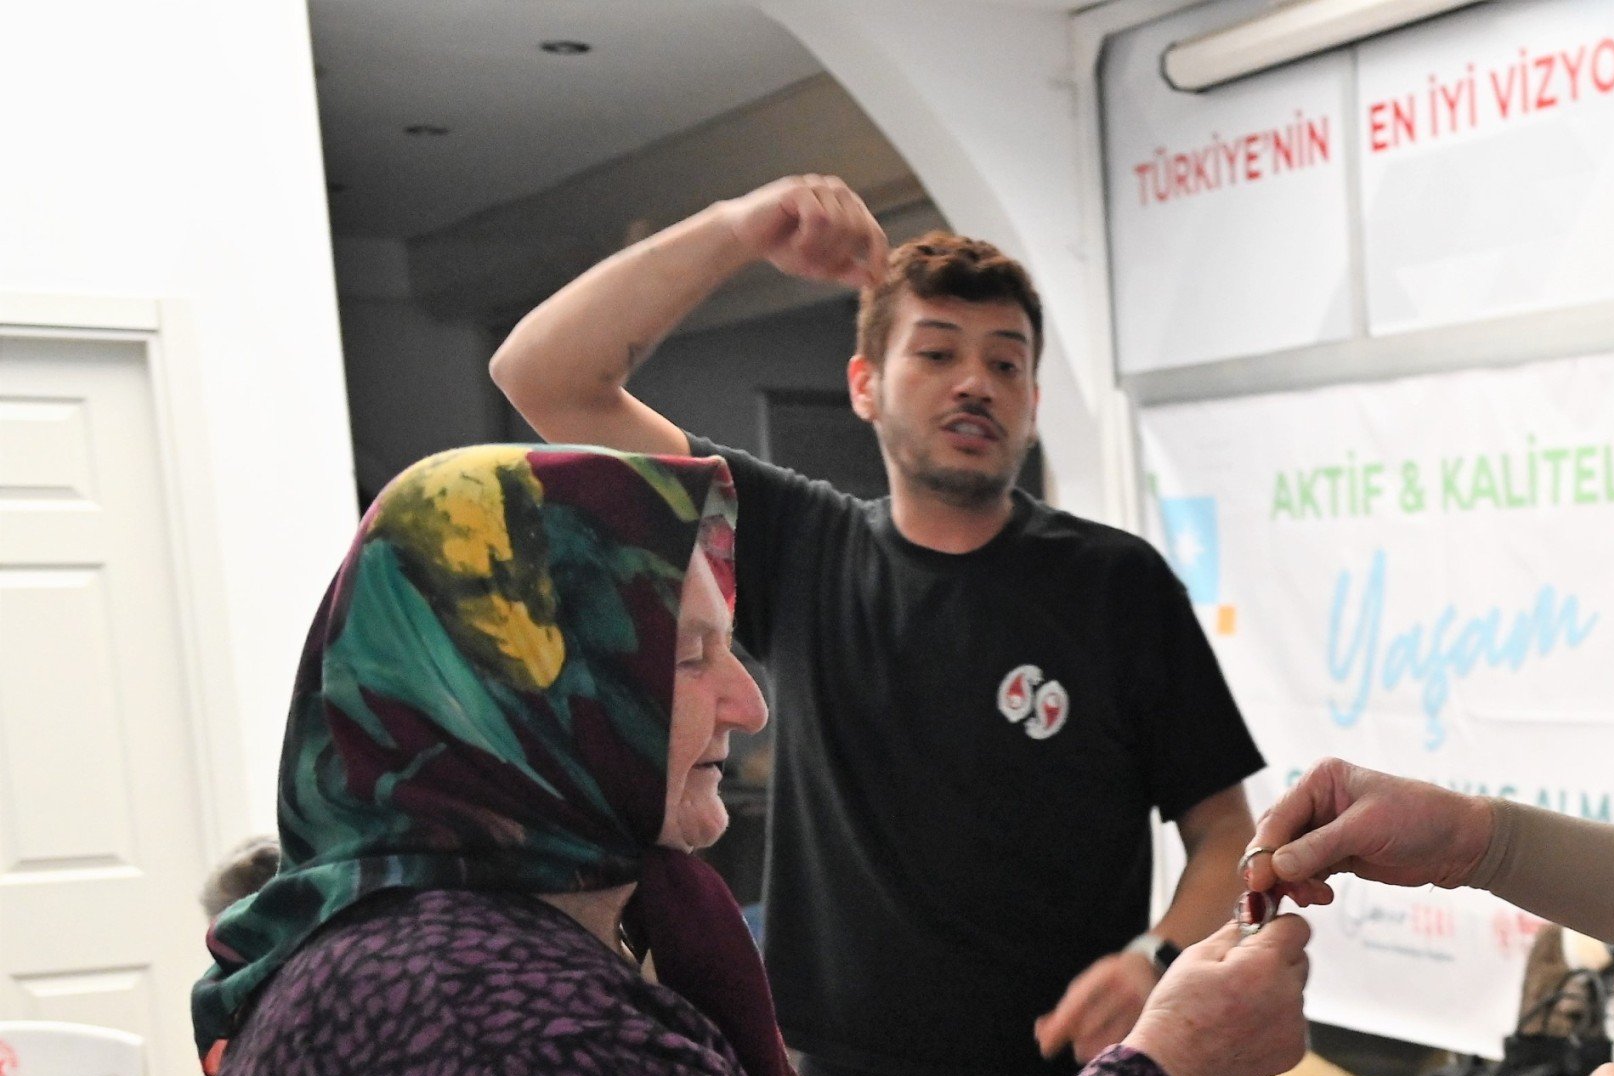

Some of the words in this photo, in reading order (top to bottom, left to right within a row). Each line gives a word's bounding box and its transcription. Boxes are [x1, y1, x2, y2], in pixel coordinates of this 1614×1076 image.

[1135, 110, 1329, 206] TÜRKİYE'NİN
[1369, 93, 1416, 151] EN
[1427, 62, 1477, 136] İYİ
[1270, 449, 1386, 521] AKTİF
[1399, 459, 1425, 513] &
[1326, 546, 1600, 751] Yaşam
